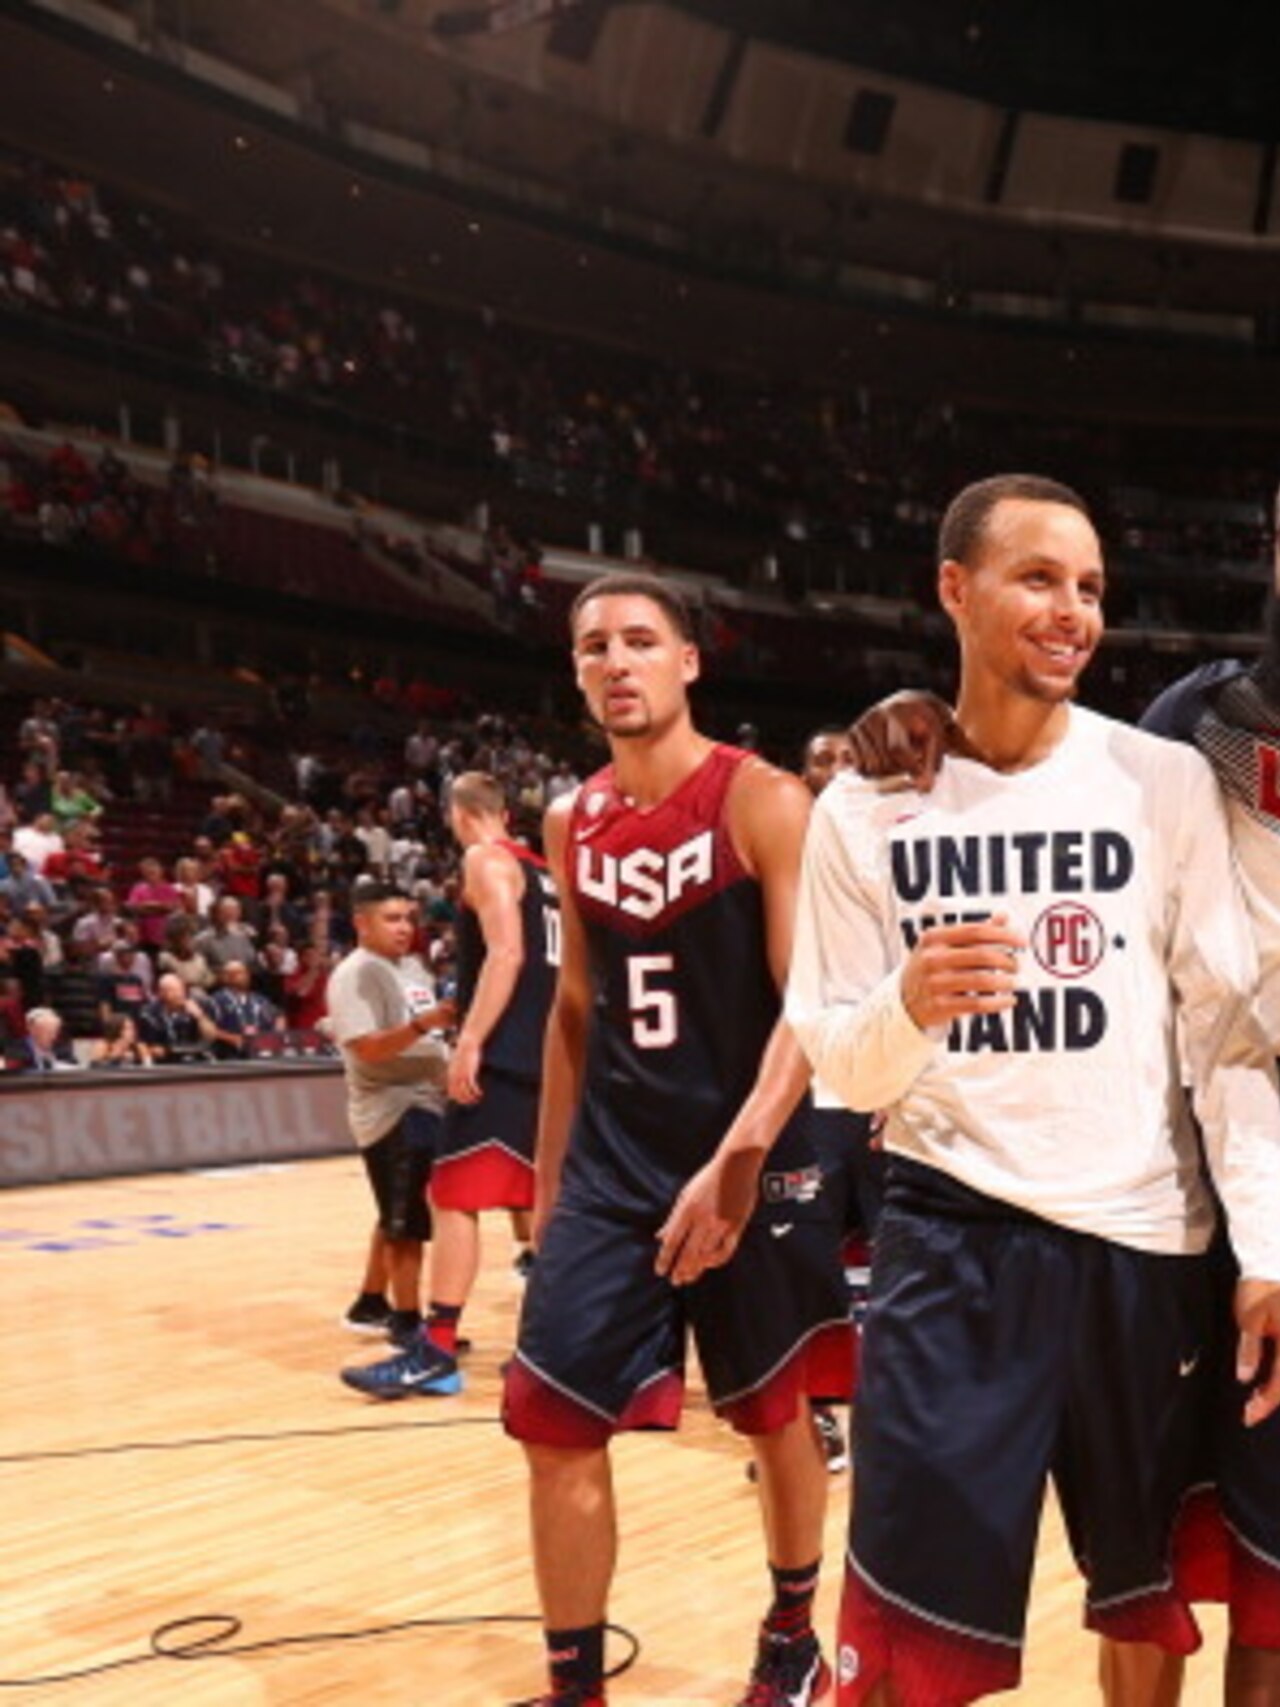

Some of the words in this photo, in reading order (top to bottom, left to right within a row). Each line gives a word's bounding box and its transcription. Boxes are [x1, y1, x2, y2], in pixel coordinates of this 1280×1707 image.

[576, 830, 714, 922] USA
[891, 829, 1134, 903] UNITED
[626, 954, 678, 1049] 5
[947, 986, 1108, 1053] AND
